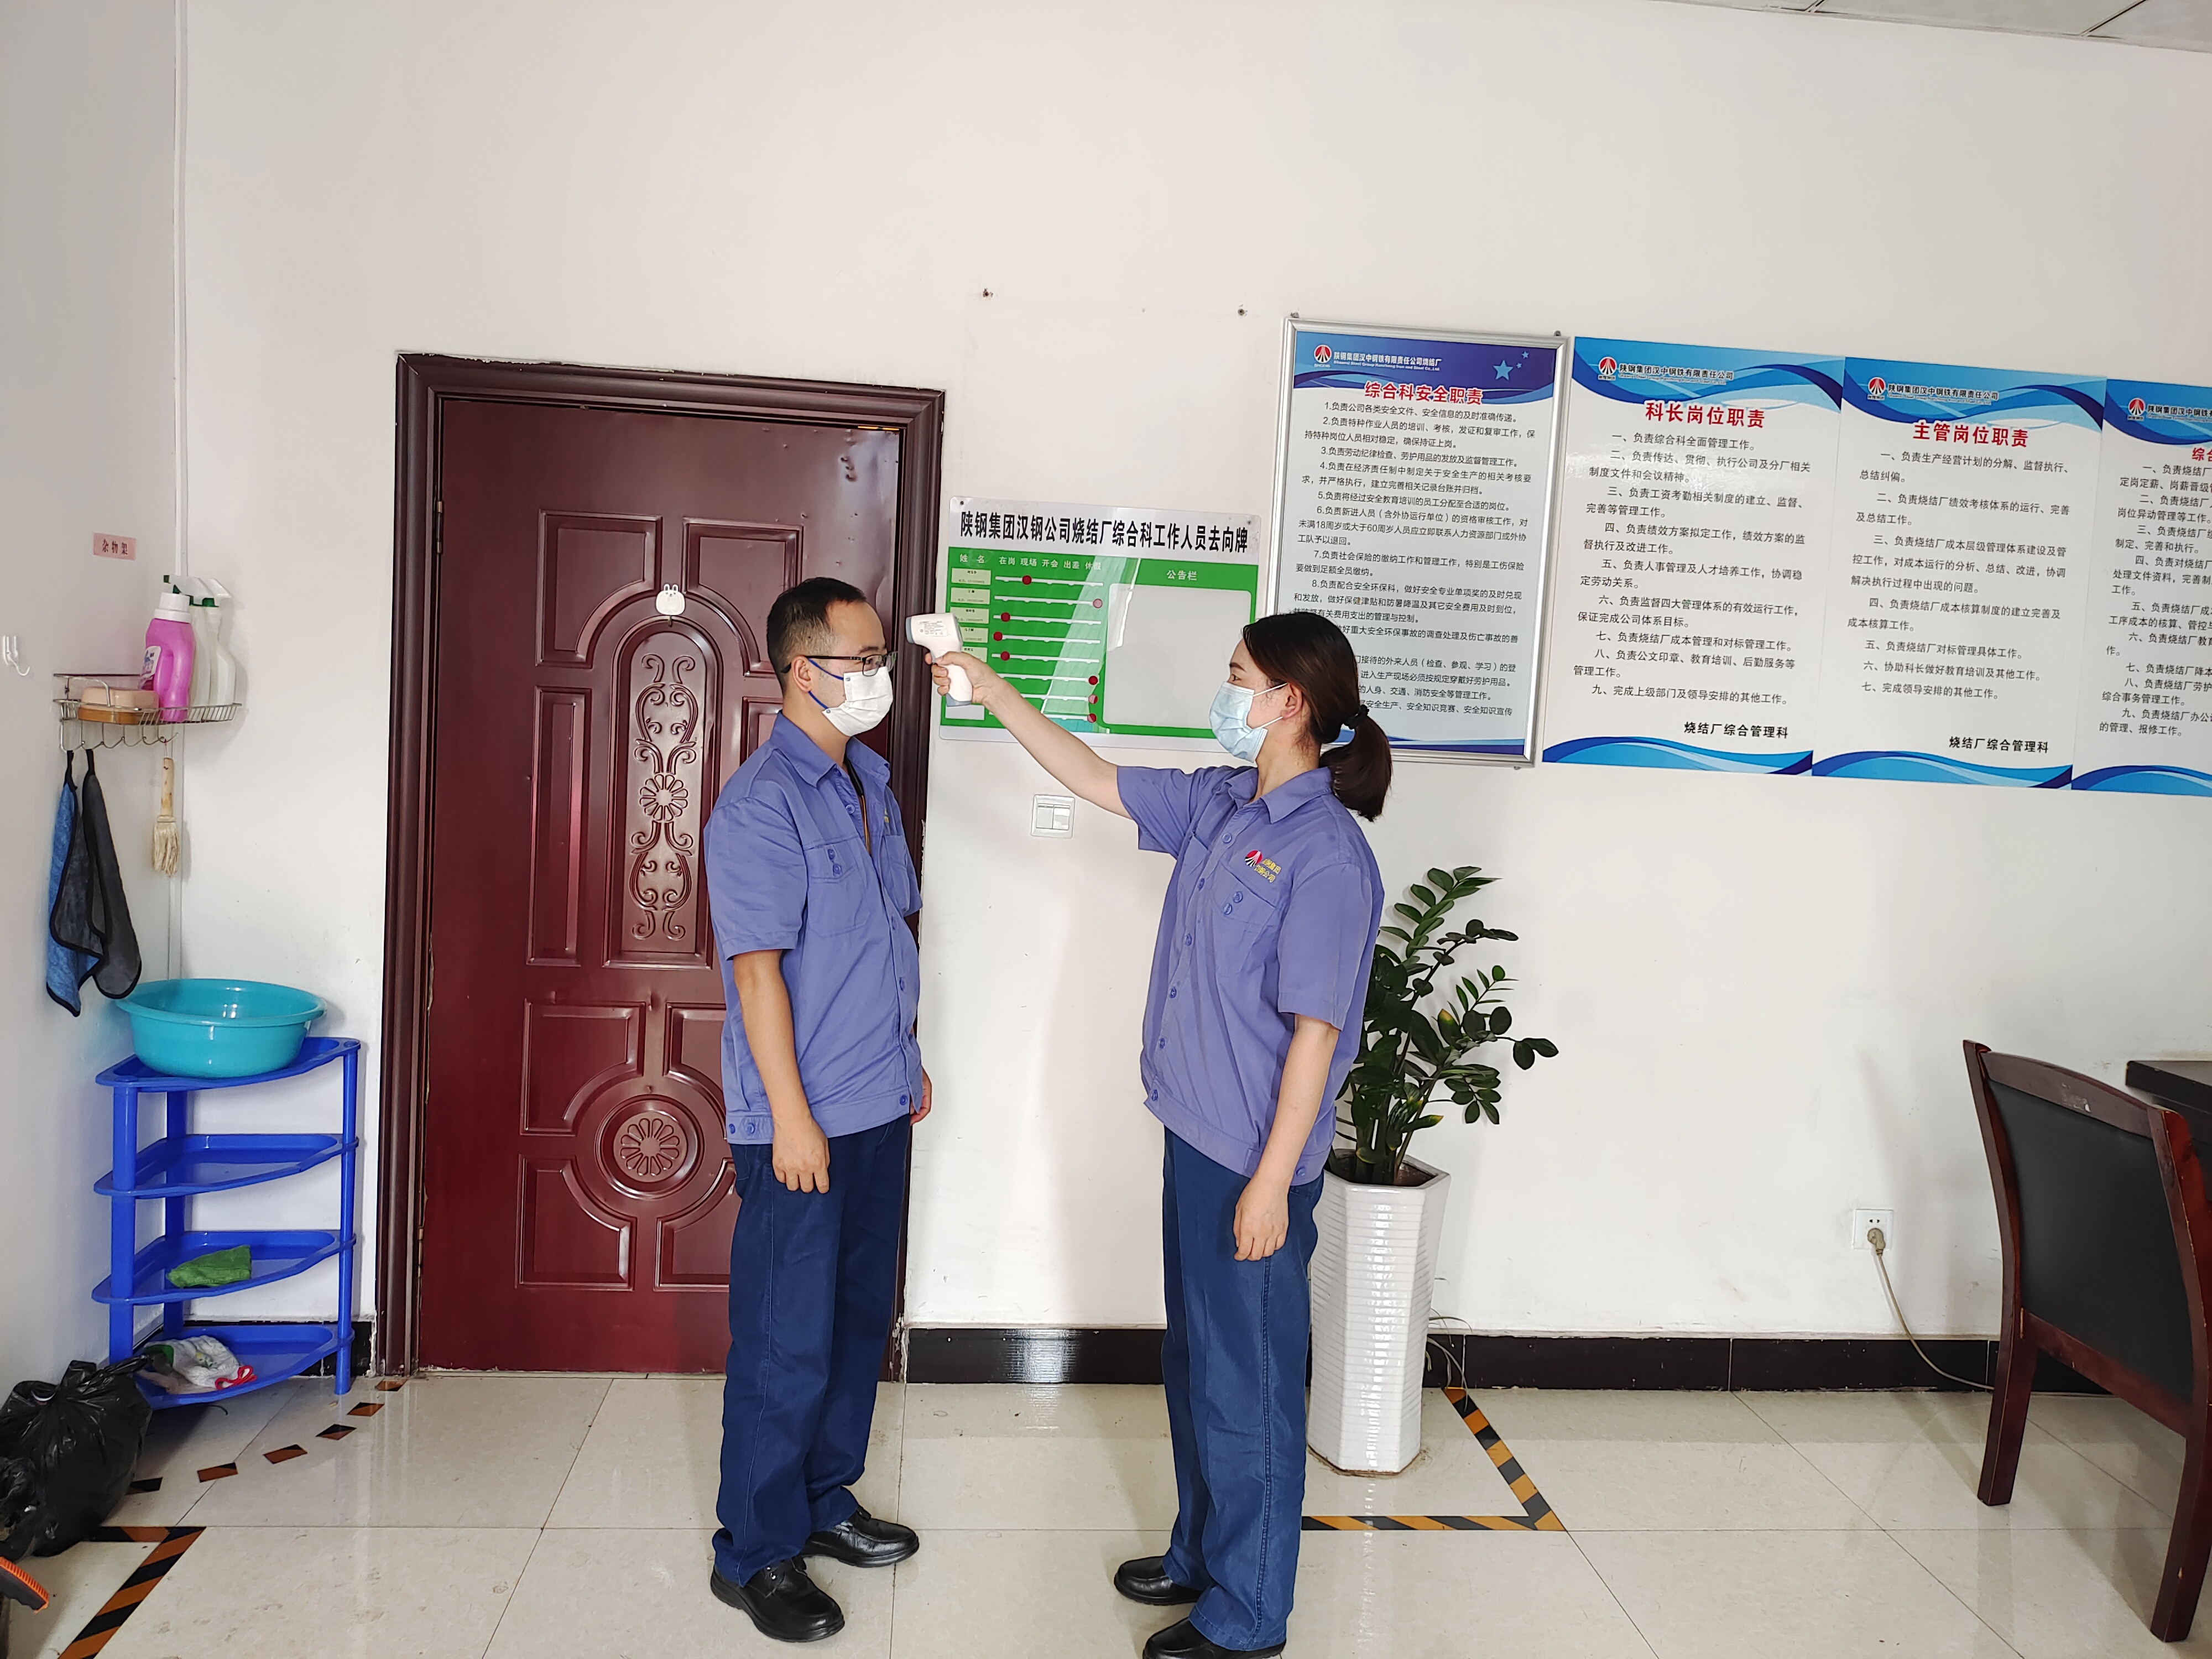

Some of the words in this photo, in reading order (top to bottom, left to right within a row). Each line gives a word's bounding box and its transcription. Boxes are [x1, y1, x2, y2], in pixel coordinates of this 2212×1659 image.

[1365, 382, 1482, 404] 综合科安全职责
[1325, 401, 1516, 422] 1.负责公司各类安全文件、安全信息的及时准确传递。
[1645, 402, 1765, 428] 科长岗位职责
[1305, 429, 1455, 448] 持特种岗位人员相对稳定，确保持证上岗。
[1612, 432, 1754, 451] 一、负责综合科全面管理工作。
[1913, 422, 2028, 447] 主管岗位职责
[1881, 451, 2067, 473] 一、负责生产经营计划的分解、监督执行、
[1320, 461, 1531, 483] 4.负责在经济责任制中制定关于安全生产的相关考核要
[1589, 467, 1690, 484] 制度文件和会议精神。
[1860, 469, 1905, 483] 总结纠偏。
[1302, 474, 1482, 495] 求，并严格执行，建立完善相关记录台账并归档。
[1318, 491, 1509, 512] 5.负责将经过安全教育培训的员工分配至合适的岗位。
[1608, 484, 1802, 508] 三、负责工资考勤相关制度的建立、监督、
[1877, 493, 2069, 516] 二、负责烧结厂绩效考核体系的运行、完善
[2140, 494, 2212, 508] 二、负责烧结厂
[1586, 503, 1665, 518] 完善等管理工作。
[1856, 512, 1912, 525] 及总结工作。
[960, 511, 1248, 553] 陕钢集团汉钢公司烧结厂综合科工作人员去向牌
[1298, 534, 1350, 546] 工队予以退回。
[1605, 523, 1805, 545] 四、负责绩效方案拟定工作，绩效方案的监
[1584, 539, 1673, 555] 督执行及改进工作。
[1874, 535, 2066, 557] 三、负责烧结厂成本层级管理体系建设及管
[2115, 538, 2198, 554] 制定、完善和执行。
[999, 556, 1015, 566] 在岗
[1020, 557, 1037, 567] 现场
[1042, 559, 1058, 568] 开会
[1296, 564, 1373, 577] 要做到足额全员缴纳。
[1601, 559, 1802, 581] 五、负责人事管理及人才培养工作，协调稳
[1166, 570, 1197, 581] 公告栏
[1580, 575, 1638, 588] 定劳动关系。
[1851, 575, 1978, 593] 解决执行过程中出现的问题。
[2112, 569, 2212, 585] 处理文件资料，完善制
[2111, 585, 2135, 596] 工作。
[1599, 594, 1797, 616] 六、负责监督四大管理体系的有效运行工作，
[1869, 598, 2060, 619] 四、负责烧结厂成本核算制度的建立完善及
[2131, 601, 2212, 615] 五、负责烧结厂成
[1578, 612, 1688, 628] 保证完成公司体系目标。
[1848, 617, 1913, 632] 成本核算工作。
[1338, 624, 1518, 644] 好重大安全环保事故的调查处理及伤亡事故的善
[1596, 630, 1791, 652] 七、负责烧结厂成本管理和对标管理工作。
[1865, 640, 2021, 659] 五、负责烧结厂对标管理具体工作。
[2106, 645, 2120, 656] 作。
[1595, 649, 1795, 670] 八、负责公文印章、教育培训、后勤服务等
[1574, 665, 1620, 678] 管理工作。
[1864, 661, 2039, 681] 六、协助科长做好教育培训及其他工作。
[1592, 684, 1786, 705] 九、完成上级部门及领导安排的其他工作。
[1861, 681, 1997, 700] 七、完成领导安排的其他工作。
[2102, 691, 2184, 706] 综合事务管理工作。
[1684, 721, 1788, 739] 烧结厂综合管理科
[2100, 721, 2181, 736] 的管理、报修工作。
[1949, 736, 2048, 753] 烧结厂综合管理科
